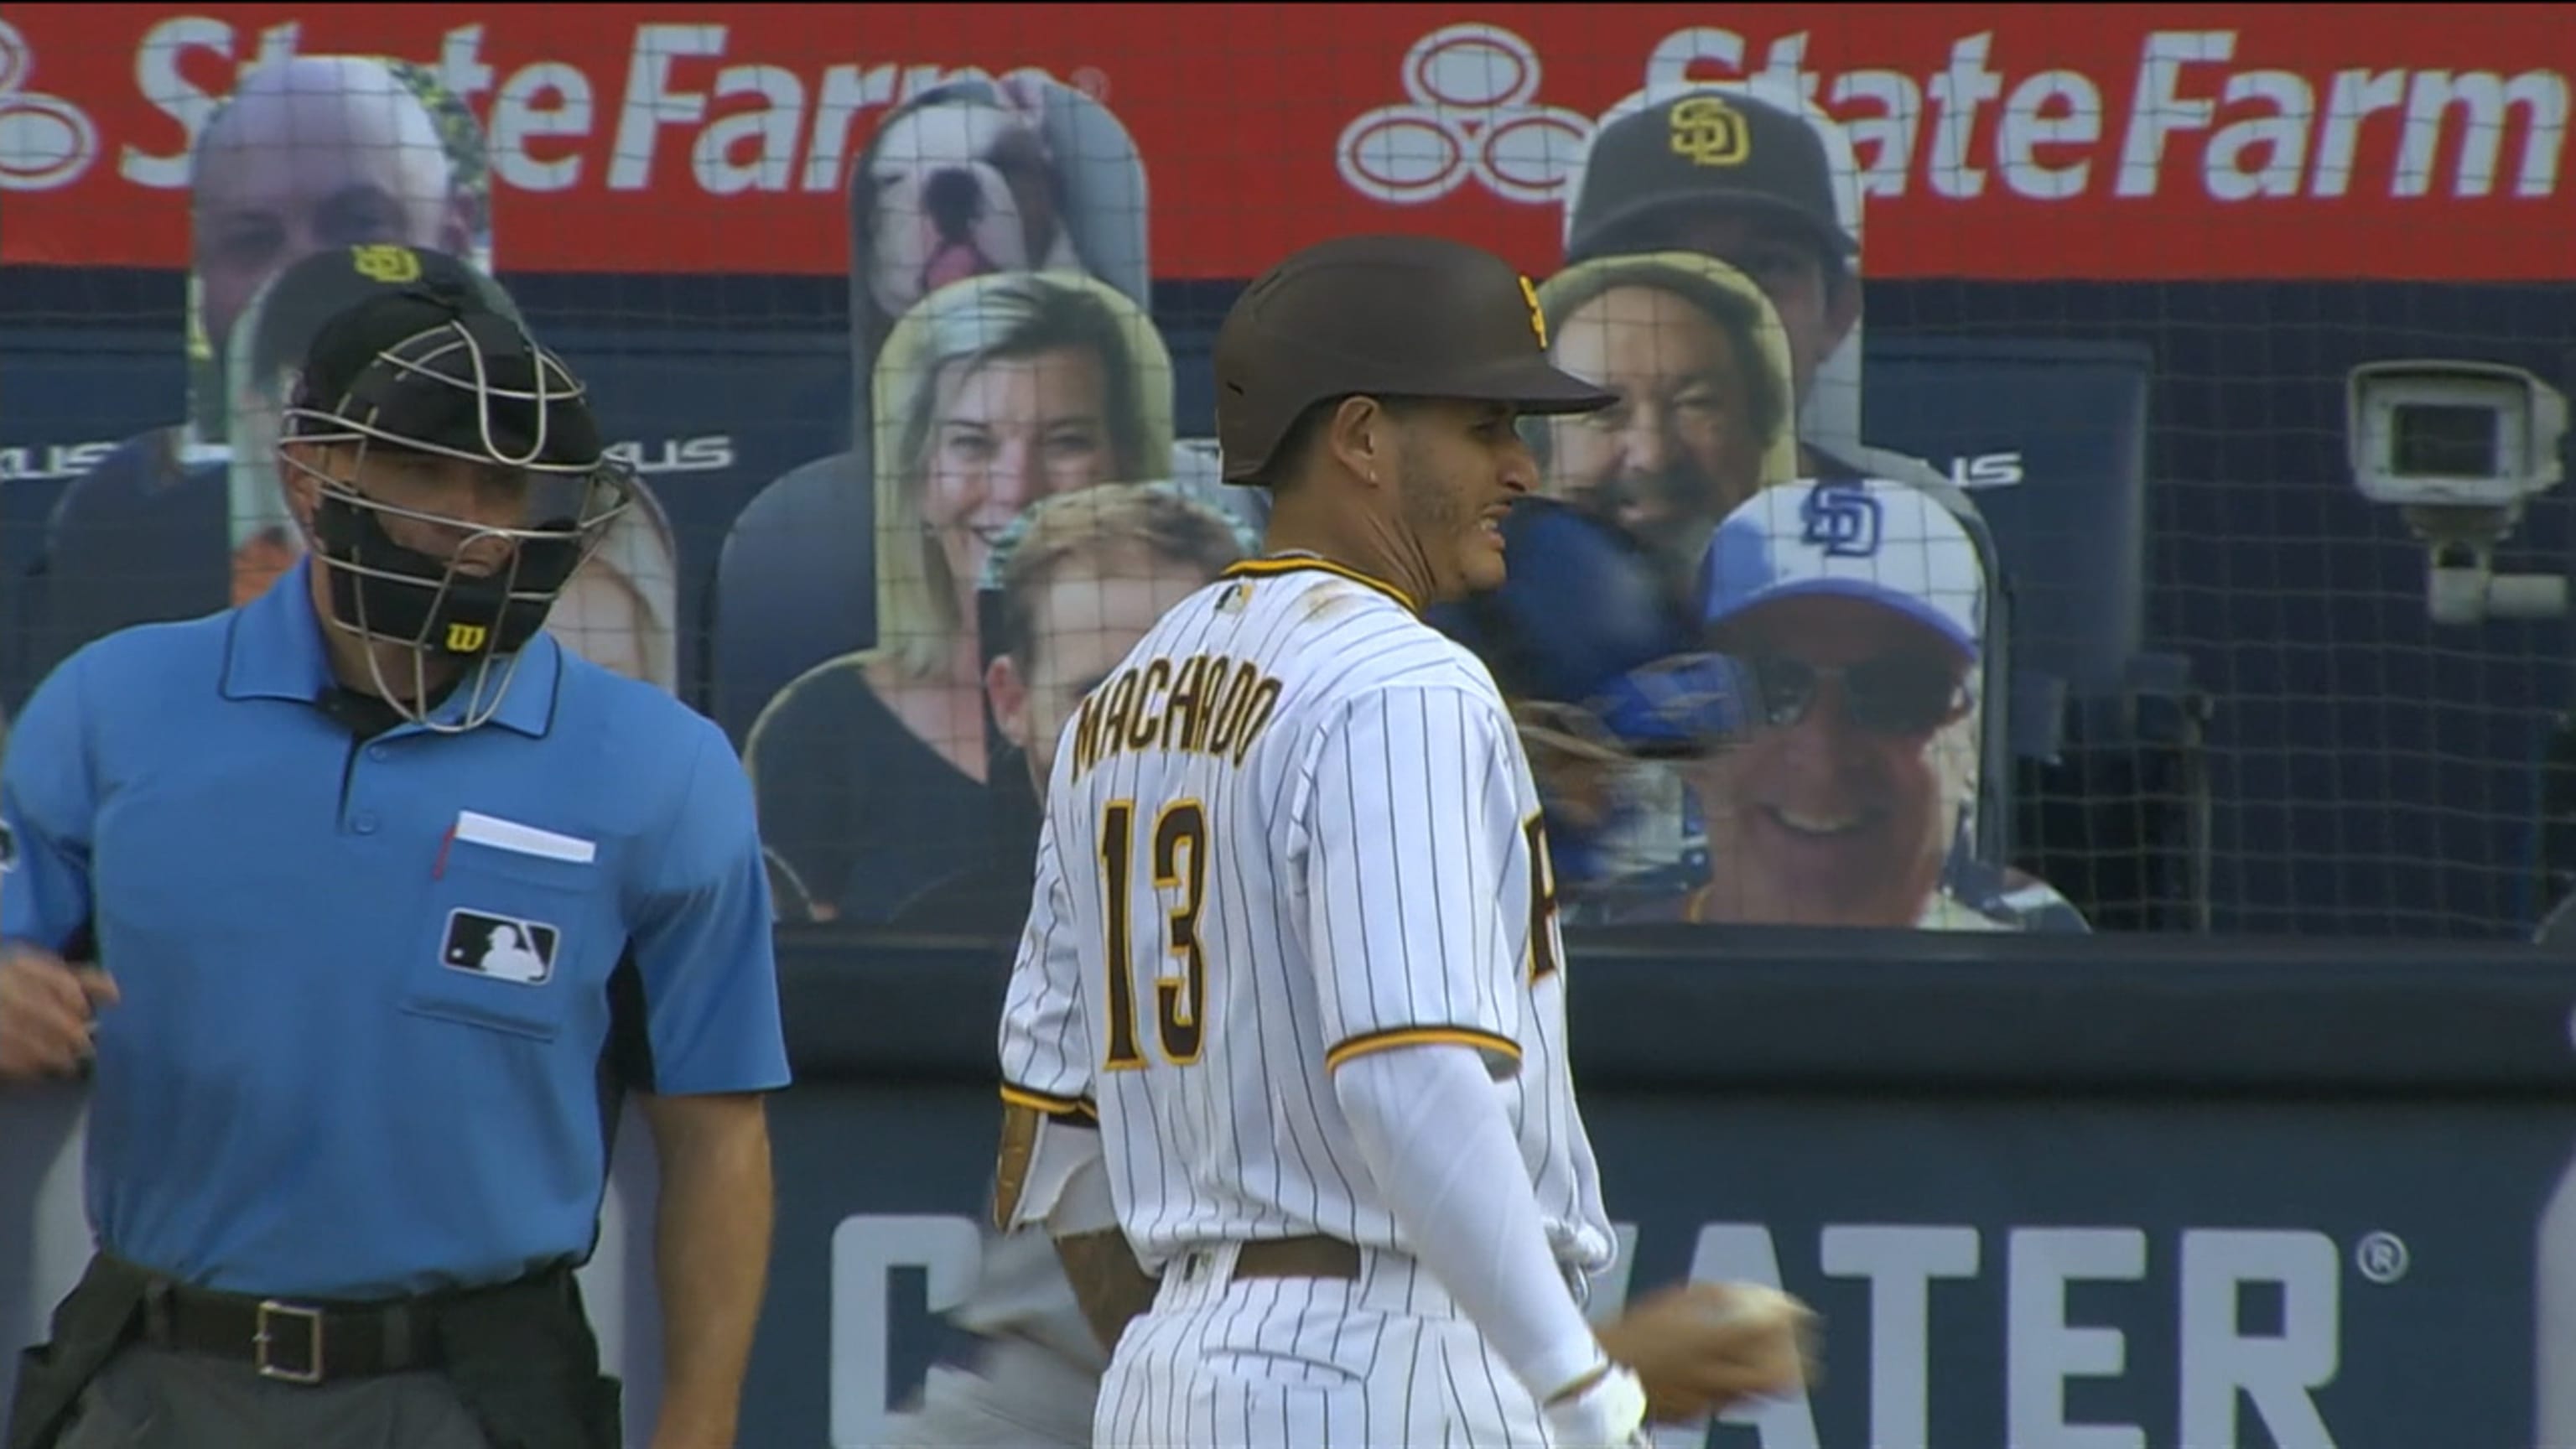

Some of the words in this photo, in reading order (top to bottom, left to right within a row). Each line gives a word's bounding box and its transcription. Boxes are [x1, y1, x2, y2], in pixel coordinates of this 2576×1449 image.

[606, 24, 1053, 195] Far
[1072, 655, 1283, 787] MACHADO
[1100, 797, 1209, 1072] 13
